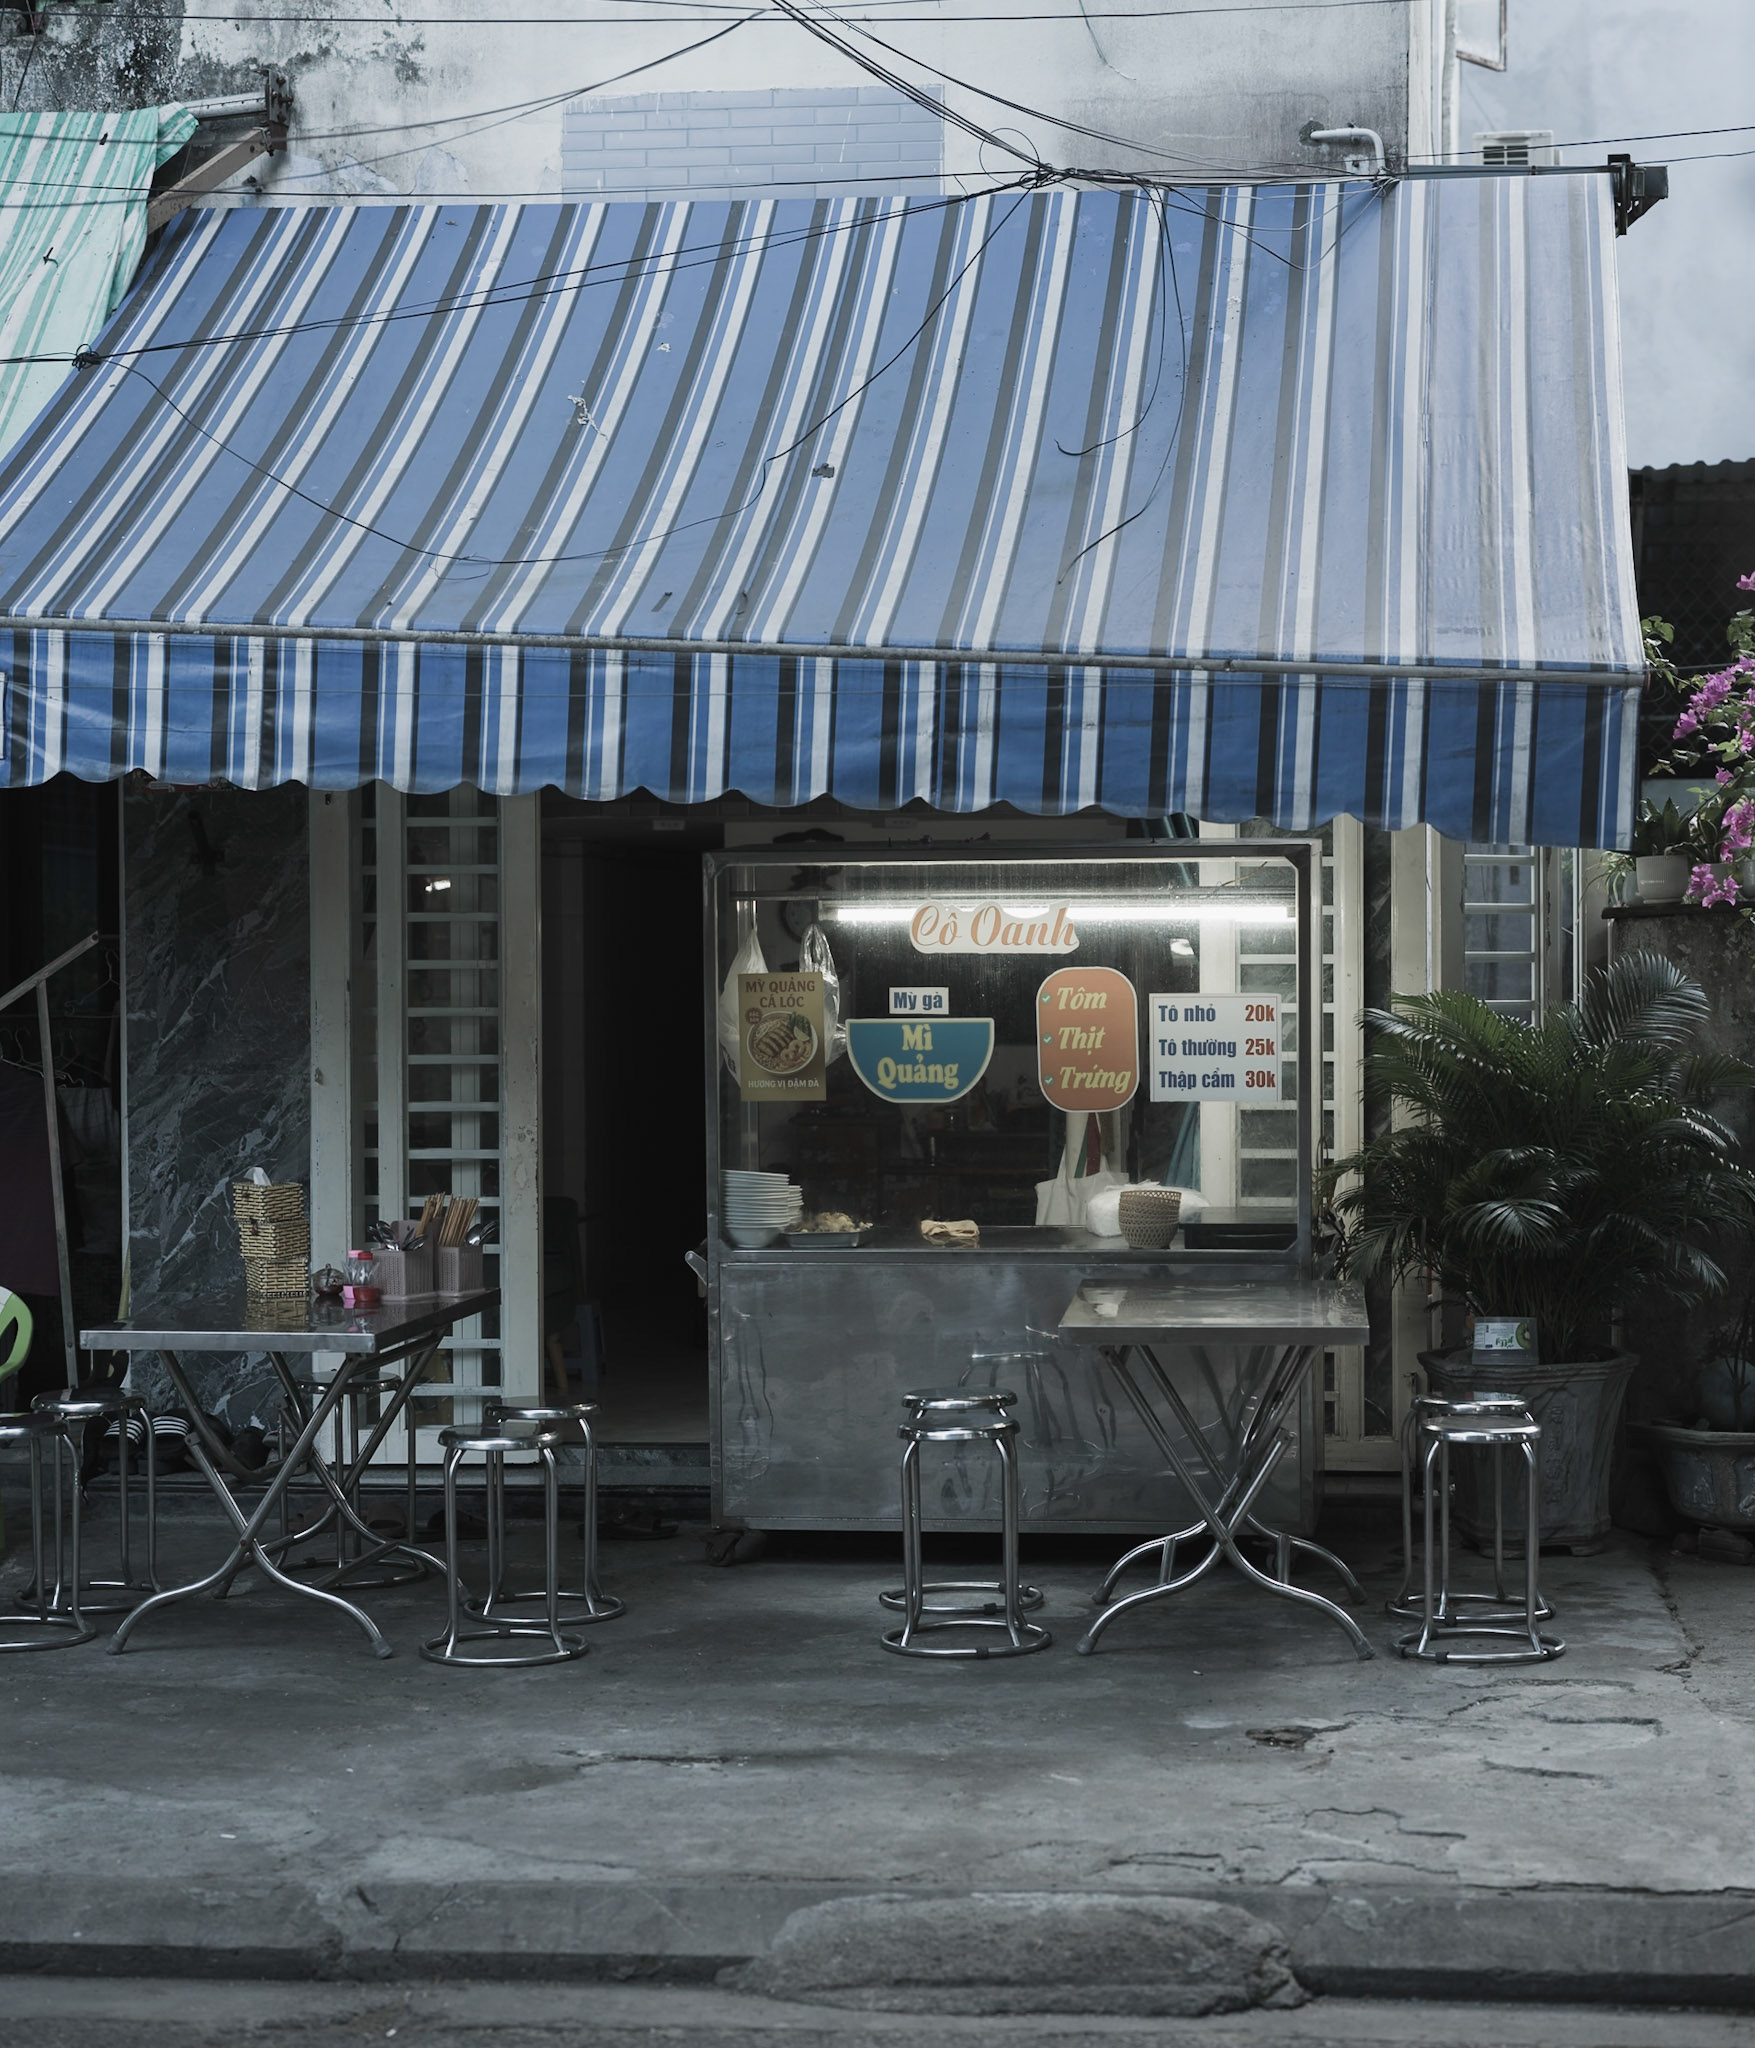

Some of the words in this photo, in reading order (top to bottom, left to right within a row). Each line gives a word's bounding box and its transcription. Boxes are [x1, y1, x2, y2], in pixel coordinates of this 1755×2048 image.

[912, 905, 961, 947] Cô
[971, 905, 1077, 947] Oanh
[769, 976, 815, 994] QUẢNG
[760, 993, 776, 1008] CÁ
[780, 993, 804, 1008] LÓC
[893, 991, 917, 1011] Mỳ
[922, 991, 943, 1011] gà
[1057, 986, 1107, 1010] Tôm
[1158, 1004, 1179, 1022] Tô
[1184, 1003, 1216, 1022] nhỏ
[1245, 1004, 1275, 1022] 20k
[901, 1023, 934, 1051] Mì
[1058, 1025, 1106, 1056] Thịt
[1158, 1038, 1177, 1056] Tô
[1182, 1038, 1237, 1058] thường
[1245, 1038, 1275, 1056] 25k
[877, 1053, 960, 1090] Quảng
[1060, 1064, 1132, 1094] Trứng
[1159, 1070, 1197, 1092] Thập
[1202, 1066, 1235, 1088] cẩm
[1245, 1070, 1276, 1088] 30k
[777, 1079, 786, 1090] VỊ
